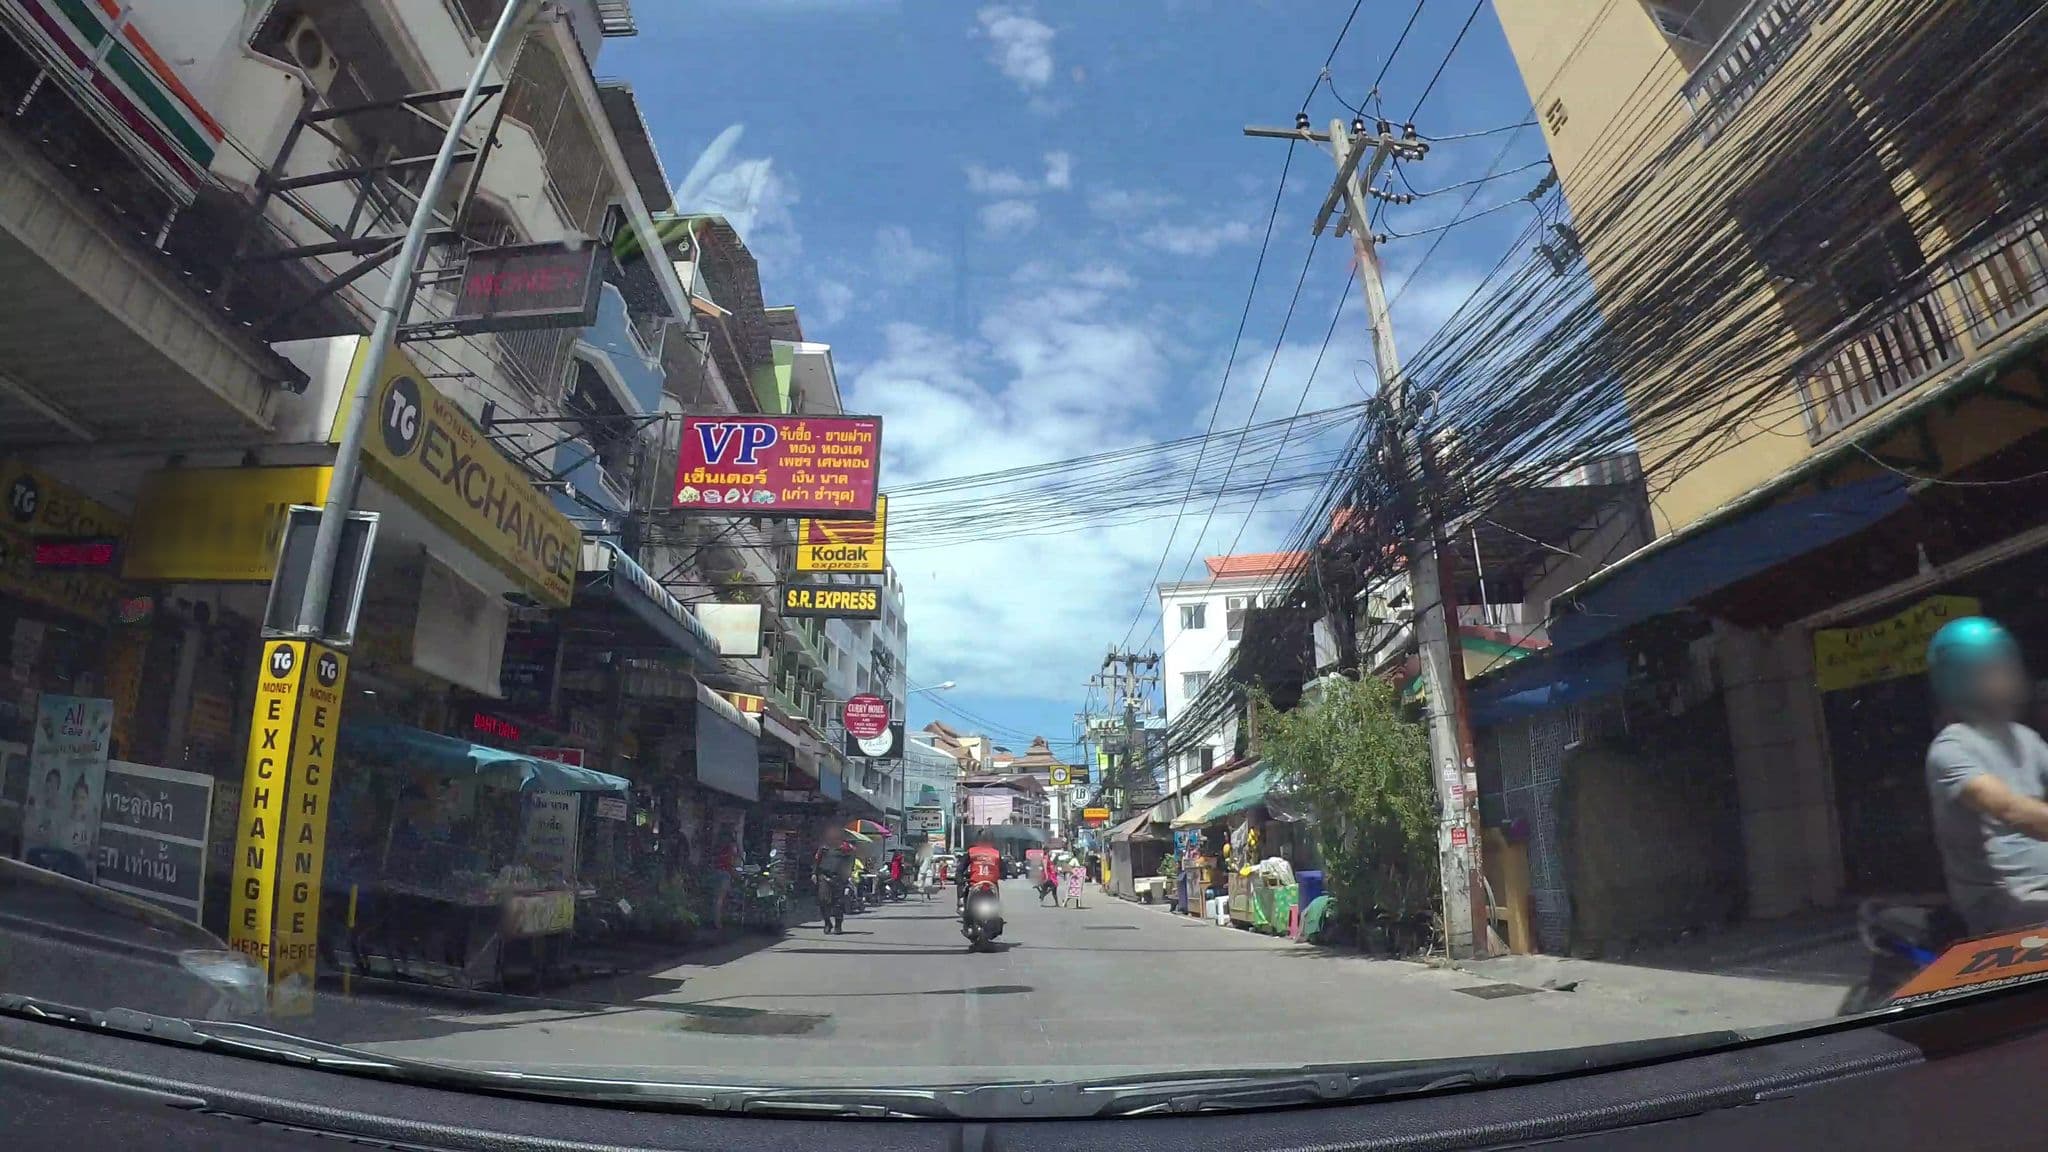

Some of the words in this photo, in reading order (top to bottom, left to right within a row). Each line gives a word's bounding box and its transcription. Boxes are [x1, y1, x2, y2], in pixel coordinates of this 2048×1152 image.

[466, 264, 580, 298] MONEY
[391, 390, 417, 441] TG
[432, 399, 478, 448] MONEY
[780, 421, 812, 441] รับซื้อ
[825, 429, 872, 442] ขายฝาก
[694, 422, 778, 465] VP
[789, 444, 816, 454] ทอง
[821, 444, 863, 455] ทองเค
[779, 456, 811, 467] เพชร
[817, 456, 870, 468] เศษทอง
[683, 466, 768, 484] เซ็นเตอร์
[792, 470, 815, 484] เงิน
[821, 473, 848, 484] นาค
[14, 482, 36, 513] TG
[419, 423, 572, 584] EXCHANGE
[782, 486, 809, 502] (เก่า
[814, 486, 854, 506] ชำรุด)
[811, 546, 868, 561] Kodak
[811, 561, 870, 570] express
[787, 589, 813, 608] S.R.
[815, 590, 877, 610] EXPRESS
[273, 652, 291, 670] TG
[320, 660, 336, 679] TG
[263, 682, 293, 694] MONEY
[309, 687, 337, 705] MONEY
[244, 699, 282, 930] EXCHANGE
[292, 706, 327, 934] EXCHANGE
[124, 843, 178, 883] เท่านั้น
[977, 864, 989, 876] 14
[231, 937, 269, 959] HERE
[279, 943, 316, 960] HERE
